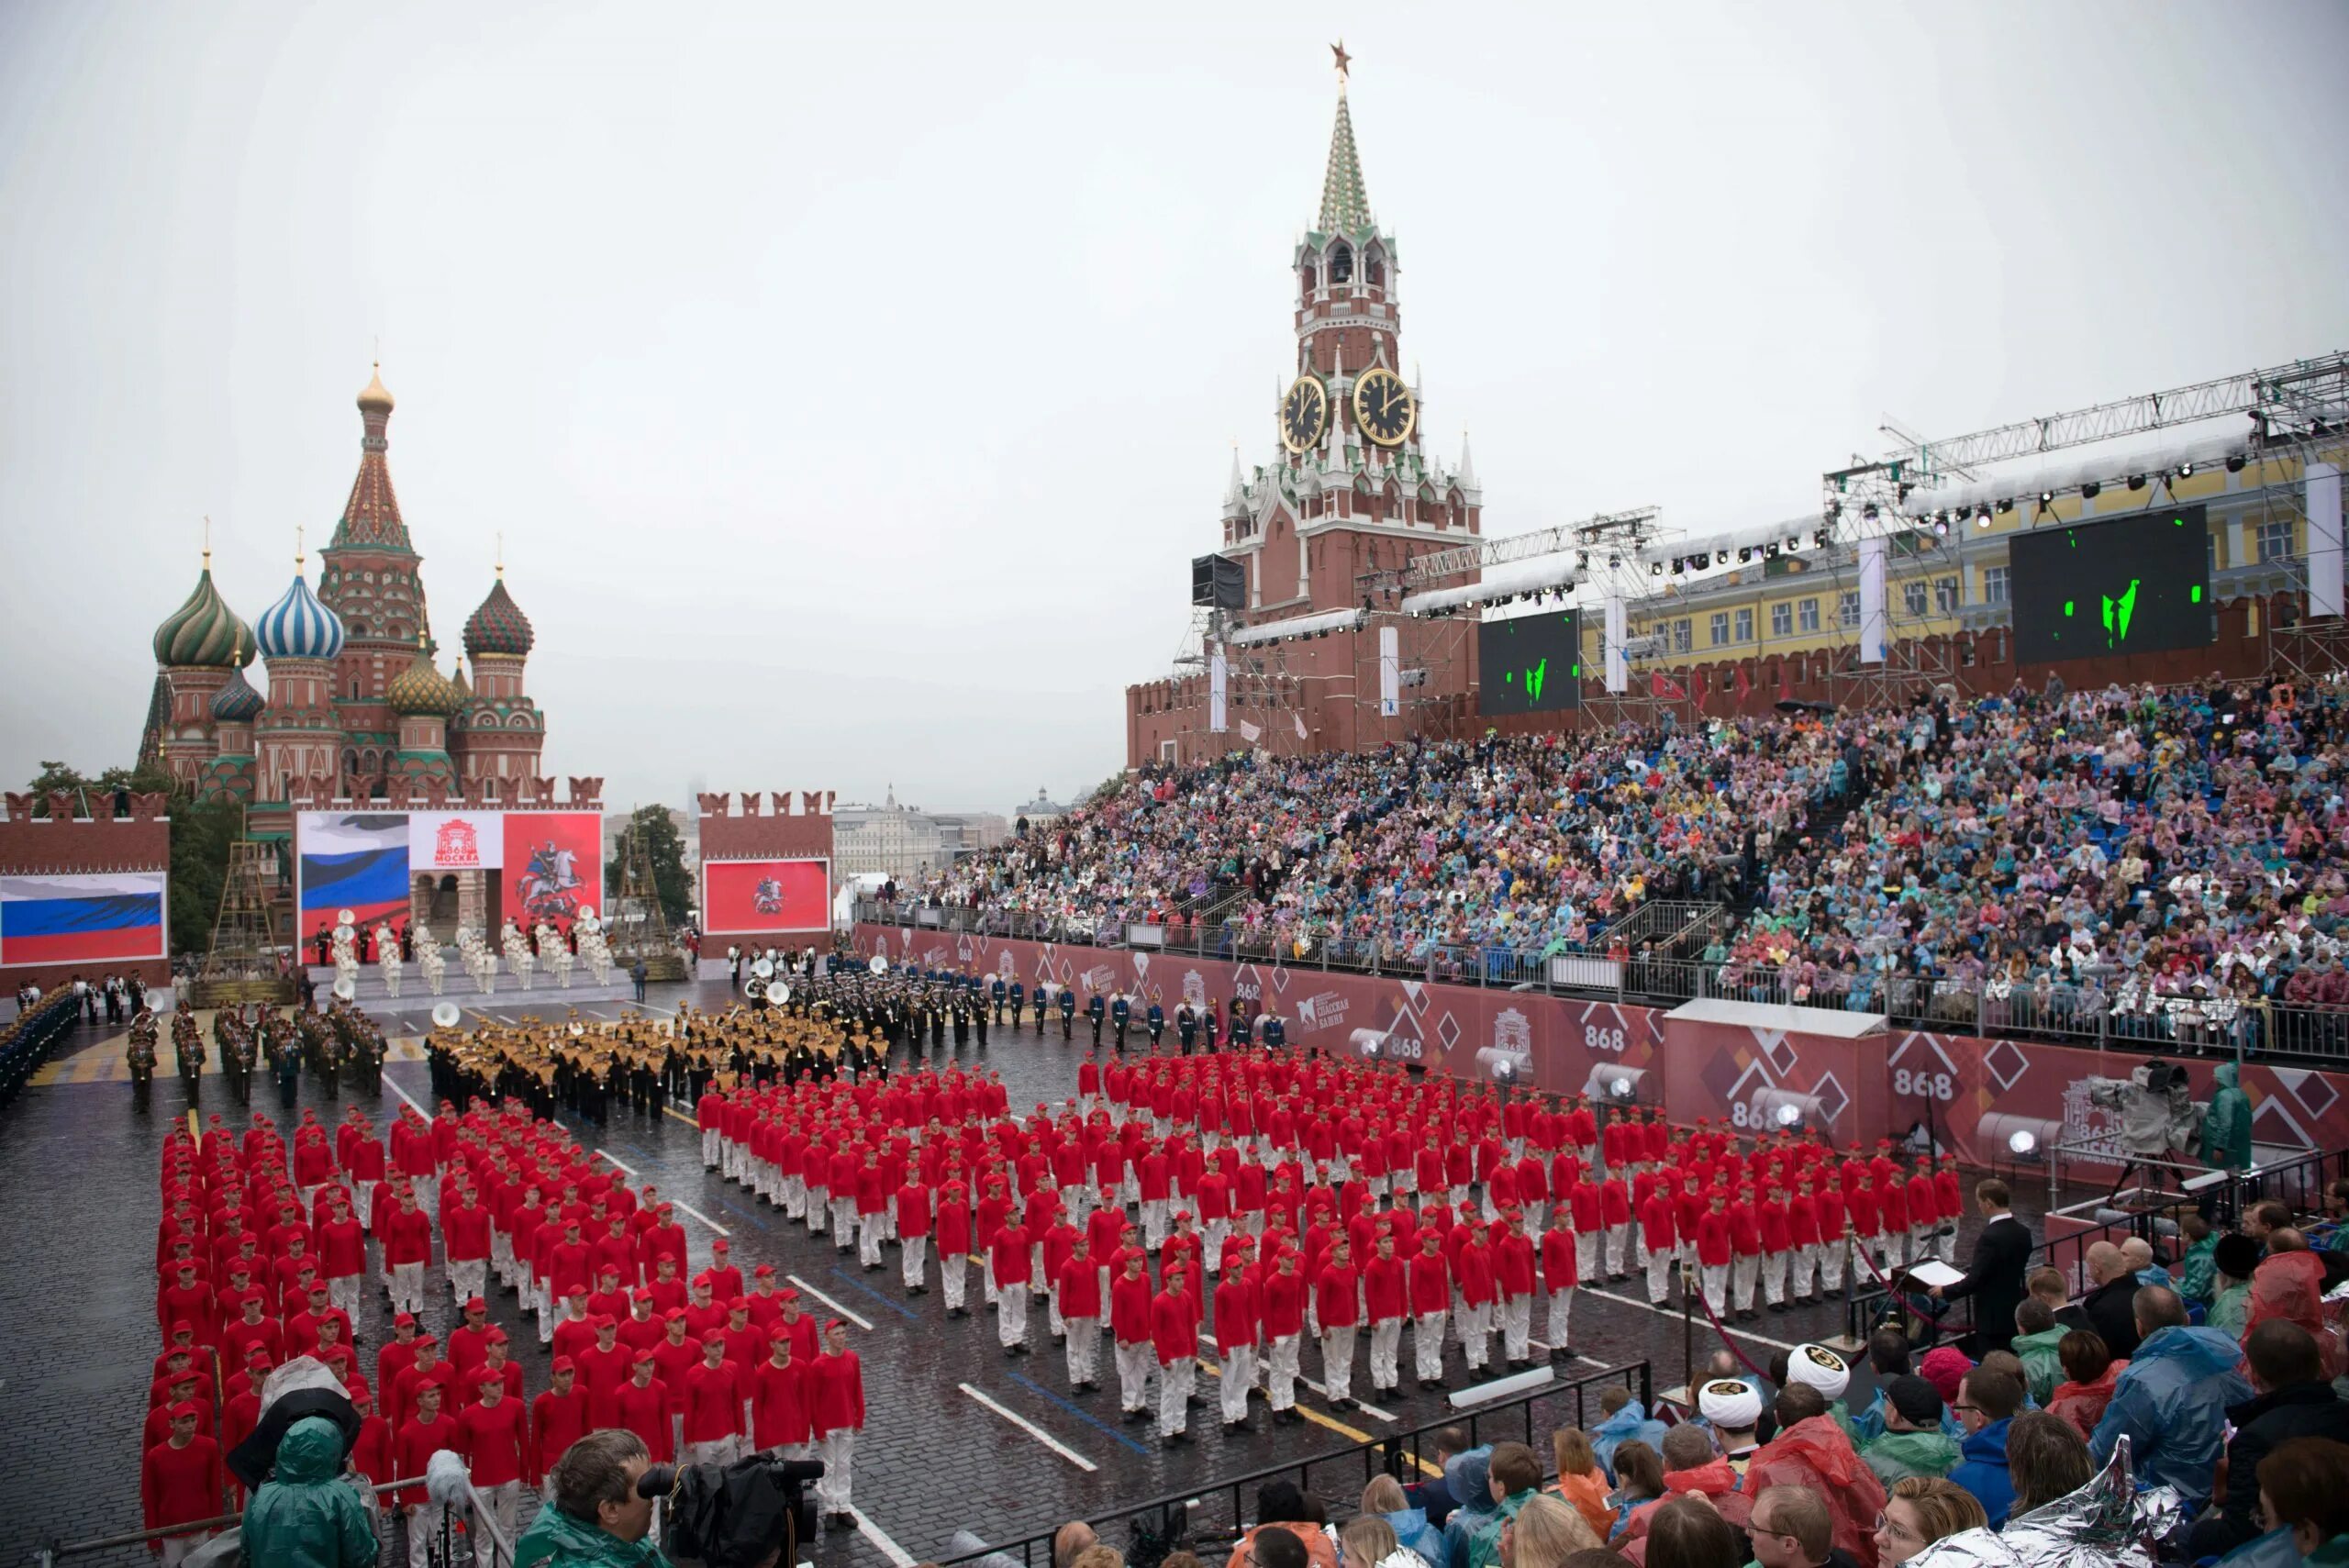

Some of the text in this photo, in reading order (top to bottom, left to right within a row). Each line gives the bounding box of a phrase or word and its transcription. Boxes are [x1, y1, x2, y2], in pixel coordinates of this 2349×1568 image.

[959, 948, 973, 962] 868
[1237, 982, 1261, 1000] 868
[1317, 998, 1349, 1018] СПАССКАЯ
[1319, 1013, 1344, 1029] БАШНЯ
[1391, 1036, 1422, 1059] 868
[1586, 1024, 1625, 1052] 868
[1894, 1068, 1954, 1101] 868
